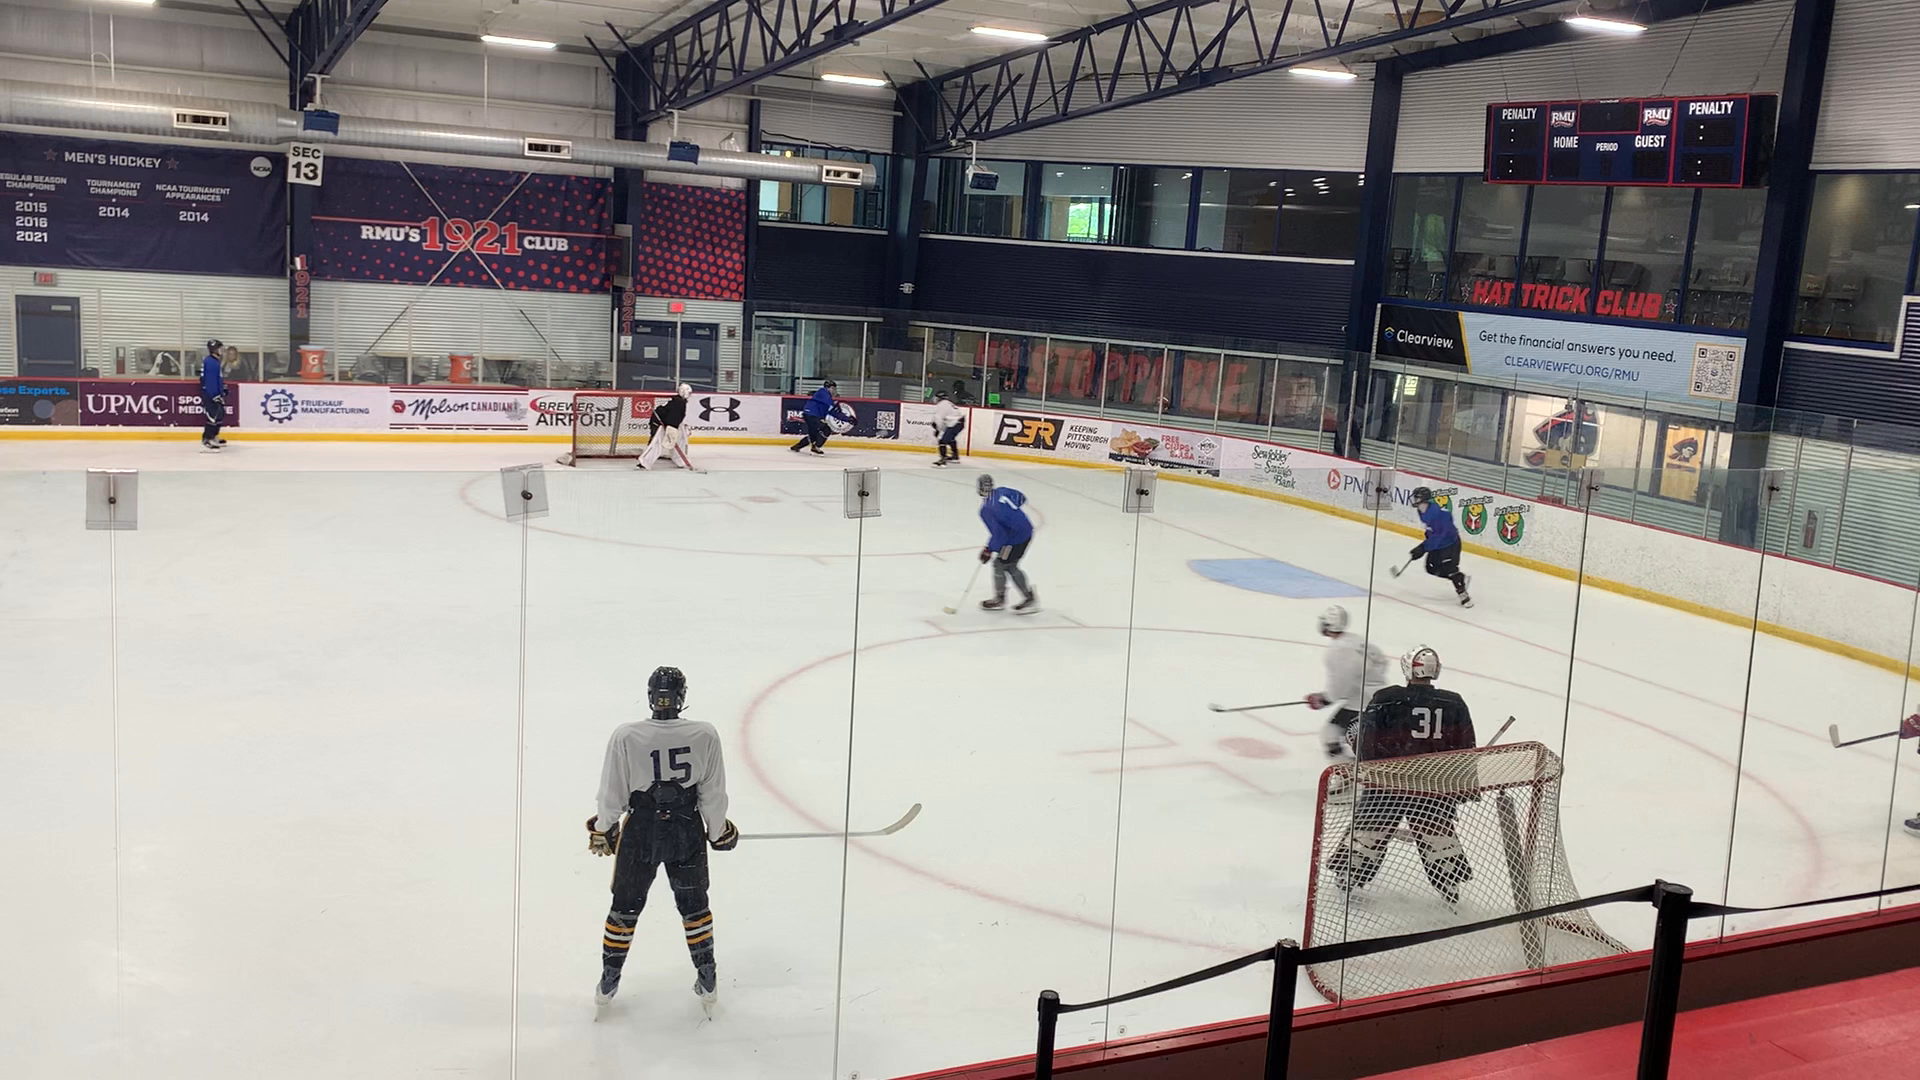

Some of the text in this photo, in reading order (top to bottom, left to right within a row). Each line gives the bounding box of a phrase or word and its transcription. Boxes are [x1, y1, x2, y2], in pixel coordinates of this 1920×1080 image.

[1502, 108, 1537, 120] PENALTY
[1643, 107, 1673, 122] RMU
[1689, 101, 1734, 115] PENALTY
[1551, 110, 1577, 123] RMU
[1553, 136, 1579, 149] HOME
[1596, 142, 1619, 152] PERIOD
[1635, 135, 1667, 148] GUEST
[292, 145, 321, 159] SEC
[64, 151, 162, 169] MEN'S HOCKEY
[291, 161, 319, 181] 13
[0, 172, 67, 185] EGULAR SEASON
[86, 179, 141, 190] TOURNAMENT
[6, 181, 56, 192] CHAMPIONS
[90, 187, 138, 197] CHAMPIONS
[156, 184, 230, 196] NCAA TOURNAMENT
[165, 192, 221, 202] APPEARANCES
[15, 201, 48, 214] 2015
[98, 206, 130, 218] 2014
[15, 216, 48, 228] 2016
[179, 211, 210, 222] 2014
[15, 231, 48, 243] 2021
[360, 216, 569, 256] RMU'S 1921 CLUB
[1472, 280, 1663, 318] HAT TRICK CLUB
[621, 282, 636, 336] 921
[761, 343, 786, 354] HAT
[1479, 330, 1677, 363] Get the financial answers you need.
[761, 360, 785, 369] CLUB
[1504, 355, 1640, 382] CLEARVIEWFCU.ORG/RMU
[18, 385, 70, 397] Experts.
[86, 394, 169, 414] UPMC
[178, 405, 233, 414] MEDE
[408, 398, 513, 420] Molson CANADIAN
[535, 408, 616, 427] AIRPORT
[1069, 424, 1098, 435] KEEPING
[1066, 433, 1109, 445] PITTSBURGH
[1161, 434, 1180, 444] FREE
[1064, 441, 1092, 451] MOVING
[1264, 460, 1293, 478] Savings
[1274, 474, 1296, 489] Bank
[658, 697, 670, 706] 25
[1411, 707, 1444, 740] 31
[650, 746, 692, 784] 15
